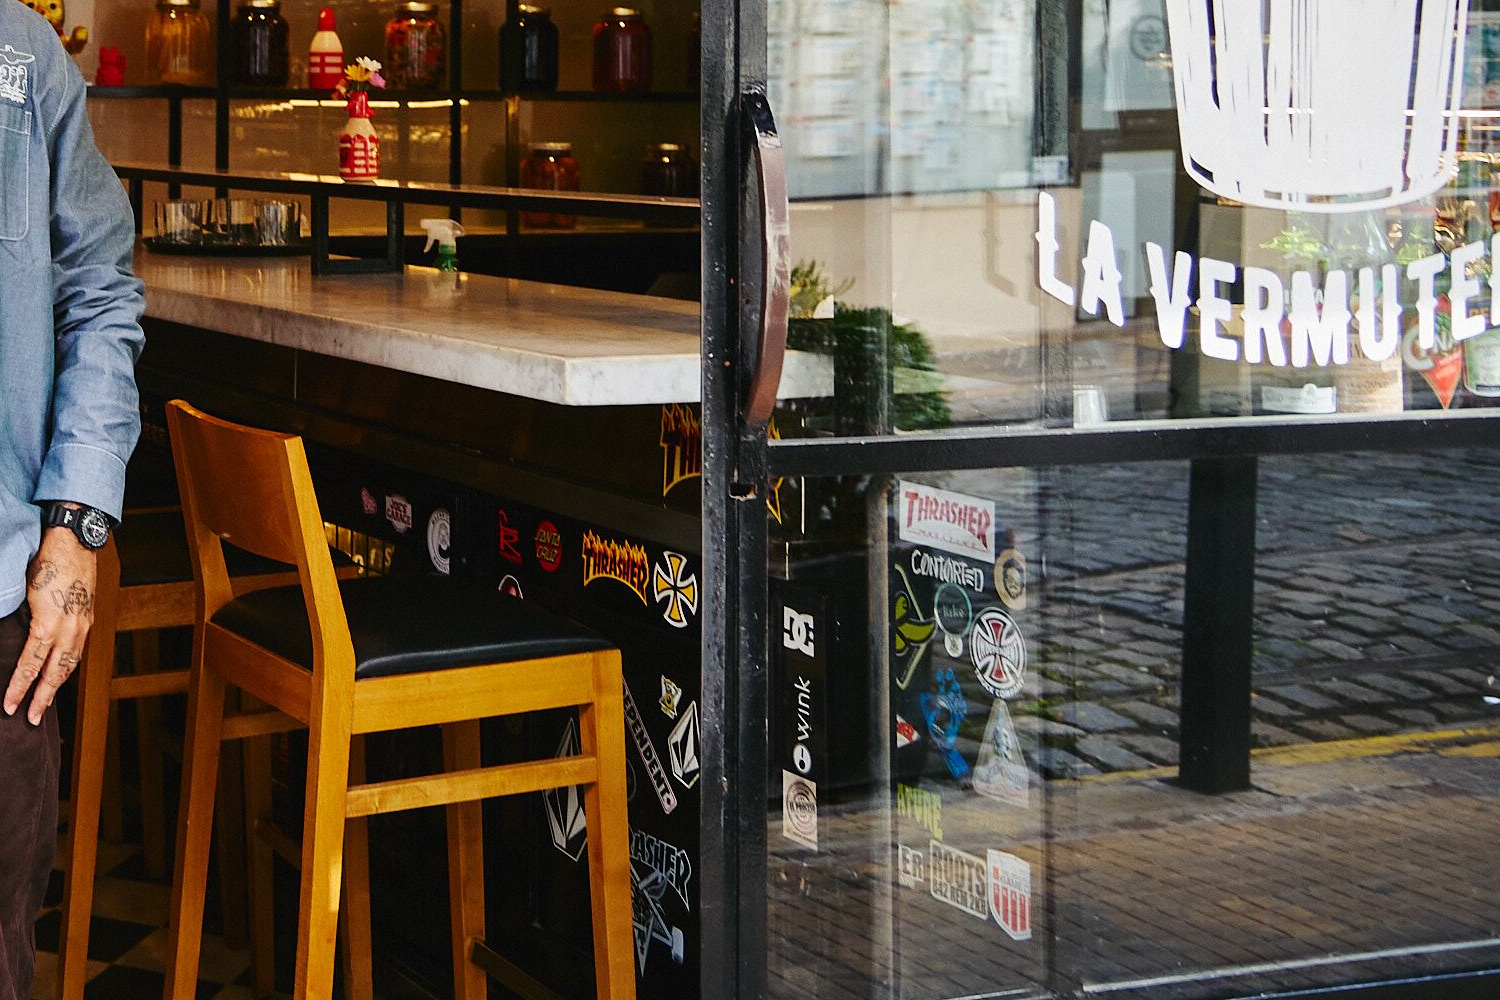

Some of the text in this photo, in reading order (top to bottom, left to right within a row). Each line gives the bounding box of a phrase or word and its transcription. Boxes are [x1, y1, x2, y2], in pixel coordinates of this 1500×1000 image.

[1034, 190, 1500, 368] LA VERMUTE
[905, 490, 992, 550] THRASHER
[582, 528, 650, 607] THRASHER
